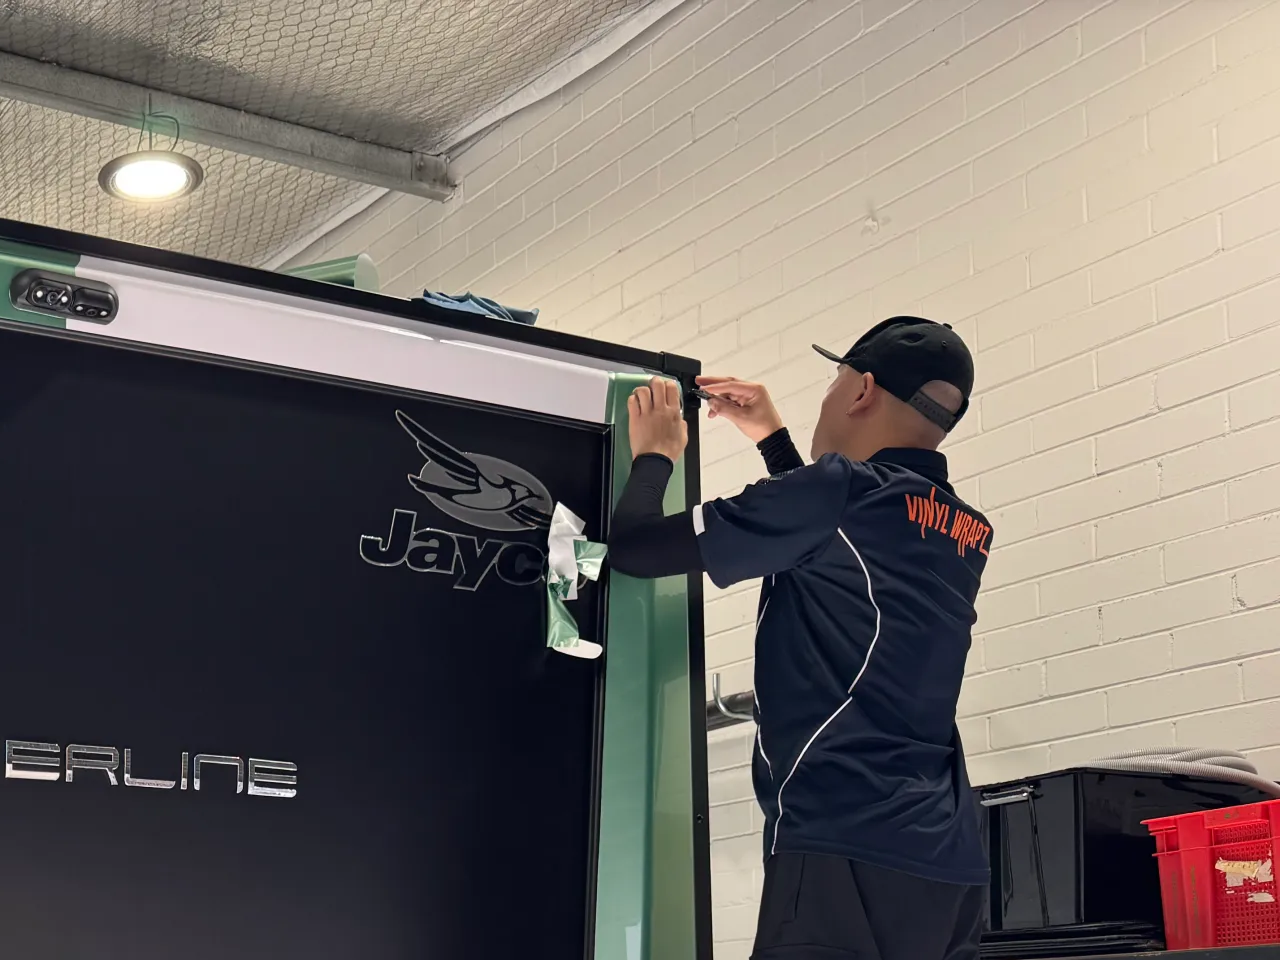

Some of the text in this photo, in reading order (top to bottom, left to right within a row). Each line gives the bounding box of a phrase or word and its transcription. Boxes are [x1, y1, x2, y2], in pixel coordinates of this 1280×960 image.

[359, 508, 589, 591] Jayc
[905, 486, 991, 557] VINYL WRAPZ
